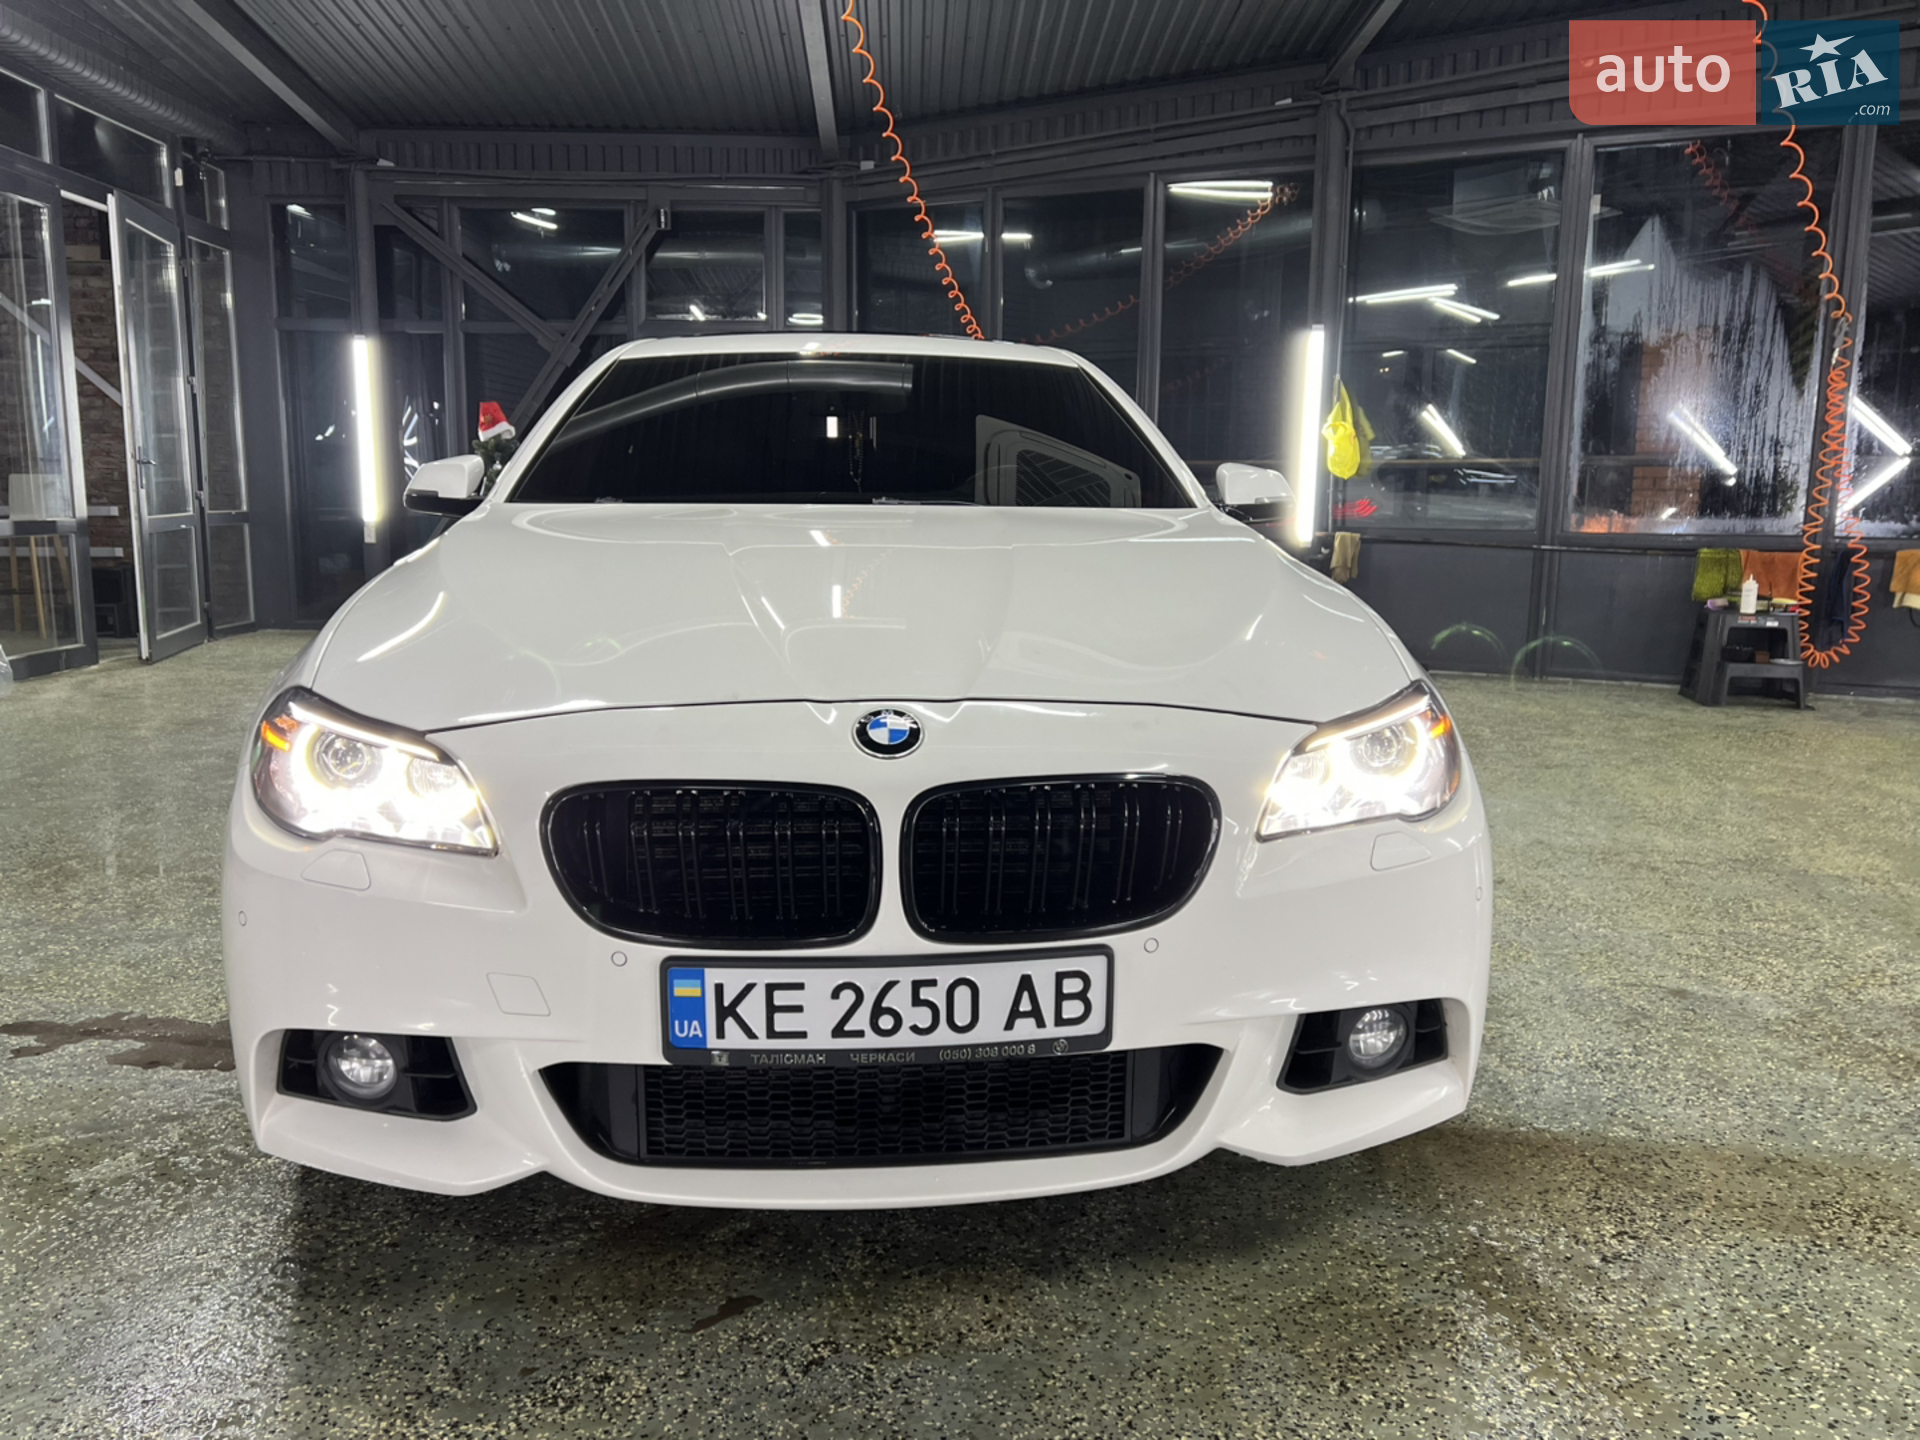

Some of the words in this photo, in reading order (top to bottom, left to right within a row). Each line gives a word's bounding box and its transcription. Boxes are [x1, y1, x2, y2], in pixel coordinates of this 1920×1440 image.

[713, 981, 808, 1040] KE
[829, 977, 980, 1039] 2650
[1003, 969, 1092, 1032] AB
[674, 1019, 704, 1038] UA
[750, 1053, 826, 1065] ТАЛІСМАН
[849, 1052, 916, 1063] ЧЕРКАСИ
